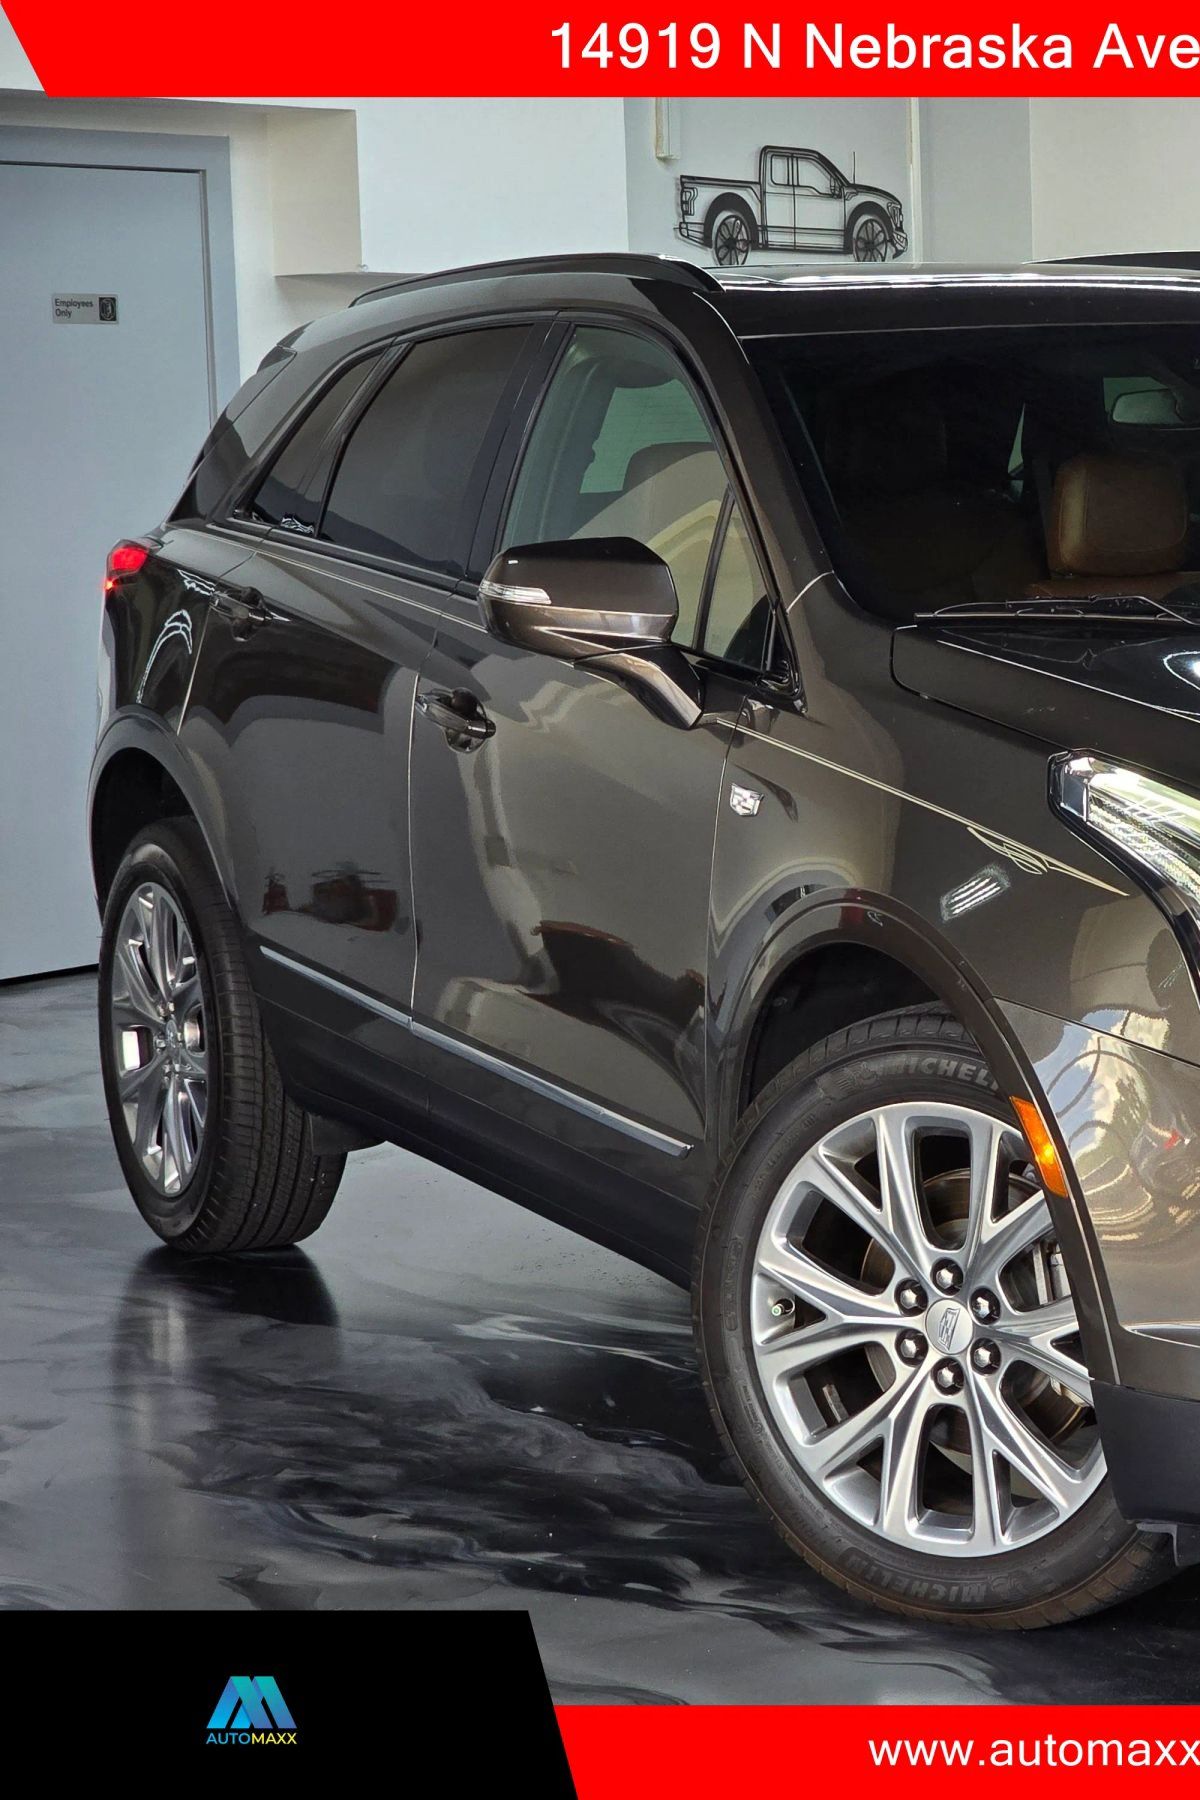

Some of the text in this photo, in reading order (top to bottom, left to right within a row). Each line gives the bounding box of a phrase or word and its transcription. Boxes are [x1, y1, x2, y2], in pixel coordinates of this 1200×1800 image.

[54, 298, 94, 309] Employees
[55, 308, 73, 318] Only
[882, 1054, 1000, 1091] MICHEL
[845, 1554, 987, 1602] MICHELIN
